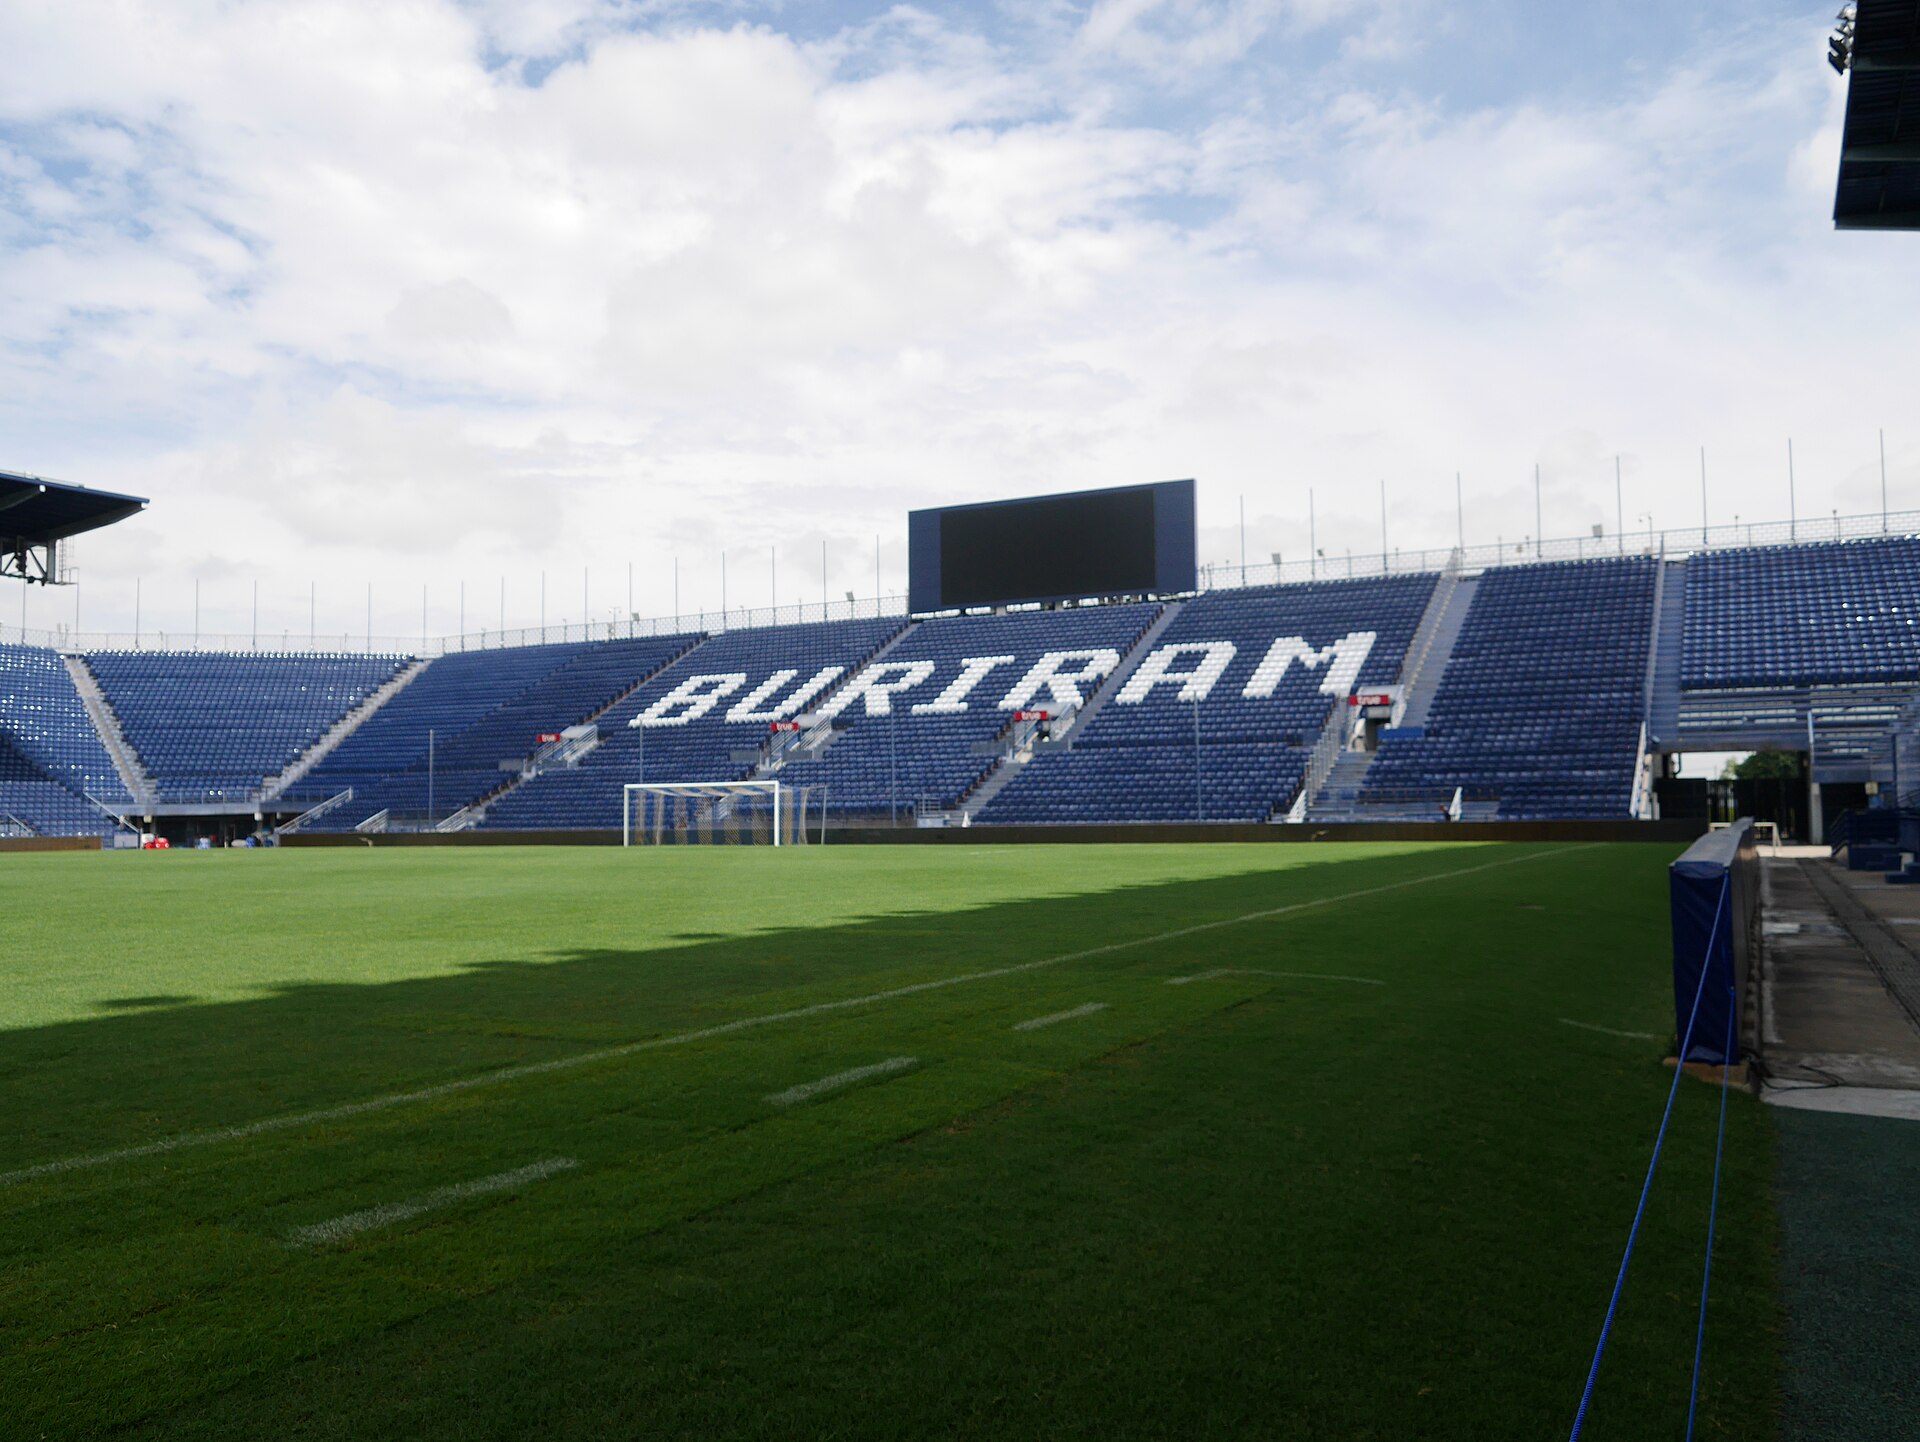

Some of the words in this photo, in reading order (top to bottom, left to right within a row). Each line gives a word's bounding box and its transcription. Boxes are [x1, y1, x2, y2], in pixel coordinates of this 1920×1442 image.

[628, 631, 1376, 727] BURIRAM
[1357, 696, 1380, 705] true
[1021, 711, 1041, 720] true
[776, 722, 793, 731] true
